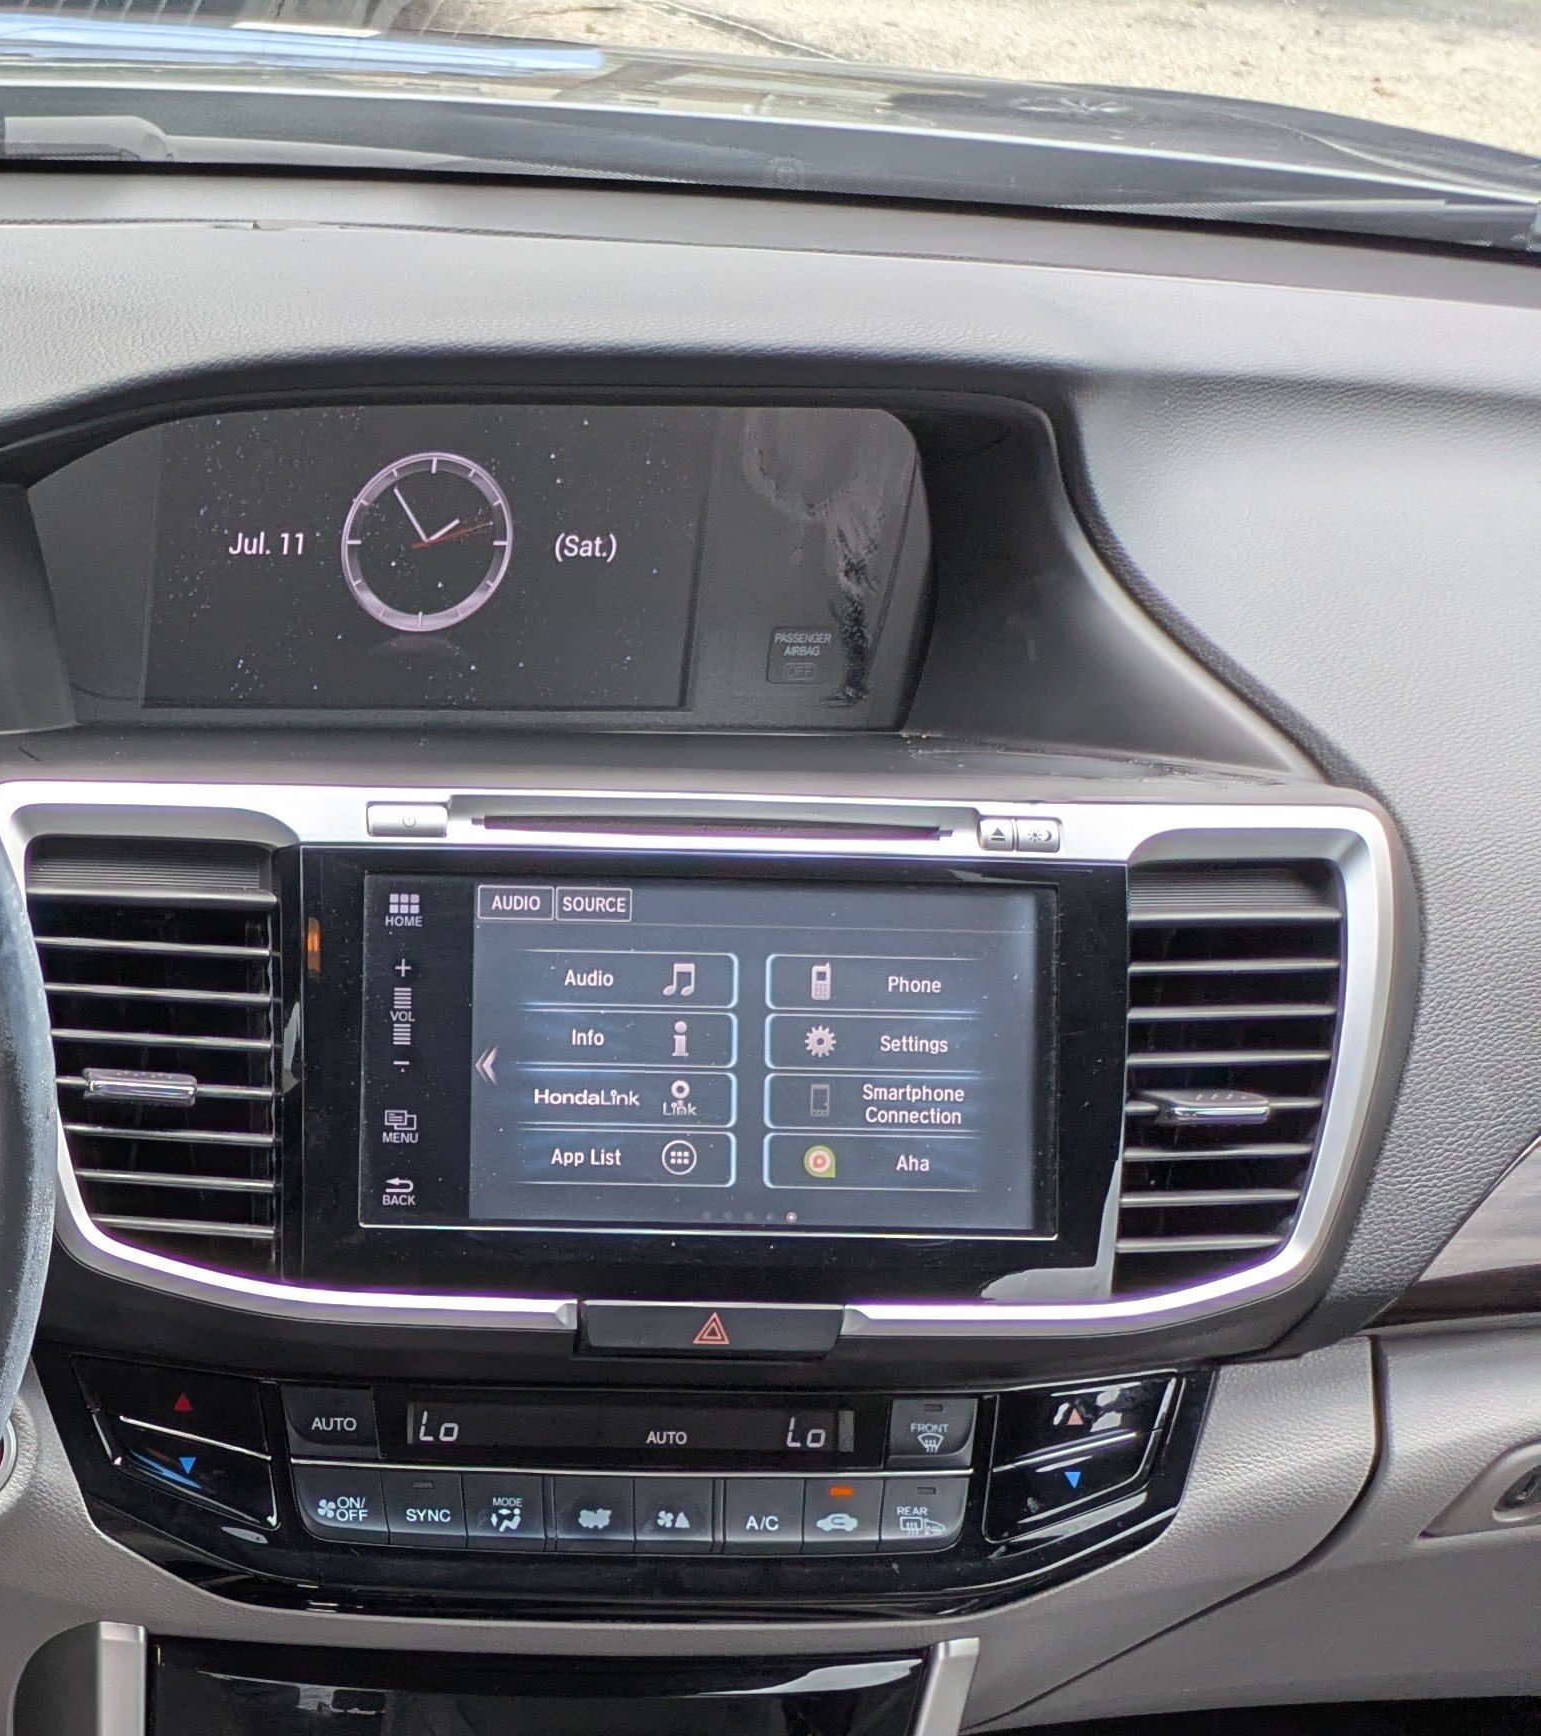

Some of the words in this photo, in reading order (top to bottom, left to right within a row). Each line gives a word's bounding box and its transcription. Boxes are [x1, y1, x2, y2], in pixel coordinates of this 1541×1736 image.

[228, 531, 271, 557] Jul.
[279, 531, 305, 556] 11
[553, 533, 618, 563] (Sat.)
[774, 632, 832, 644] PASSENGER
[783, 645, 820, 656] AIRBAG
[491, 894, 541, 913] AUDIO
[562, 895, 626, 914] SOURCE
[384, 915, 423, 928] HOME
[564, 968, 614, 988] Audio
[887, 974, 942, 994] Phone
[390, 1010, 416, 1023] VOL
[570, 1028, 605, 1047] Info
[880, 1034, 948, 1057] Settings
[862, 1082, 965, 1106] Smartphone
[864, 1107, 962, 1127] Connection
[382, 1131, 418, 1145] MENU
[551, 1148, 583, 1169] App
[586, 1147, 622, 1167] List
[896, 1153, 930, 1172] Aha
[382, 1194, 416, 1207] BACK
[311, 1416, 357, 1432] AUTO
[910, 1422, 949, 1434] FRONT
[646, 1430, 687, 1446] AUTO
[492, 1496, 523, 1507] MODE
[336, 1508, 368, 1522] OFF
[405, 1508, 451, 1523] SYNC
[896, 1506, 928, 1517] REAR
[745, 1515, 779, 1531] A/C
